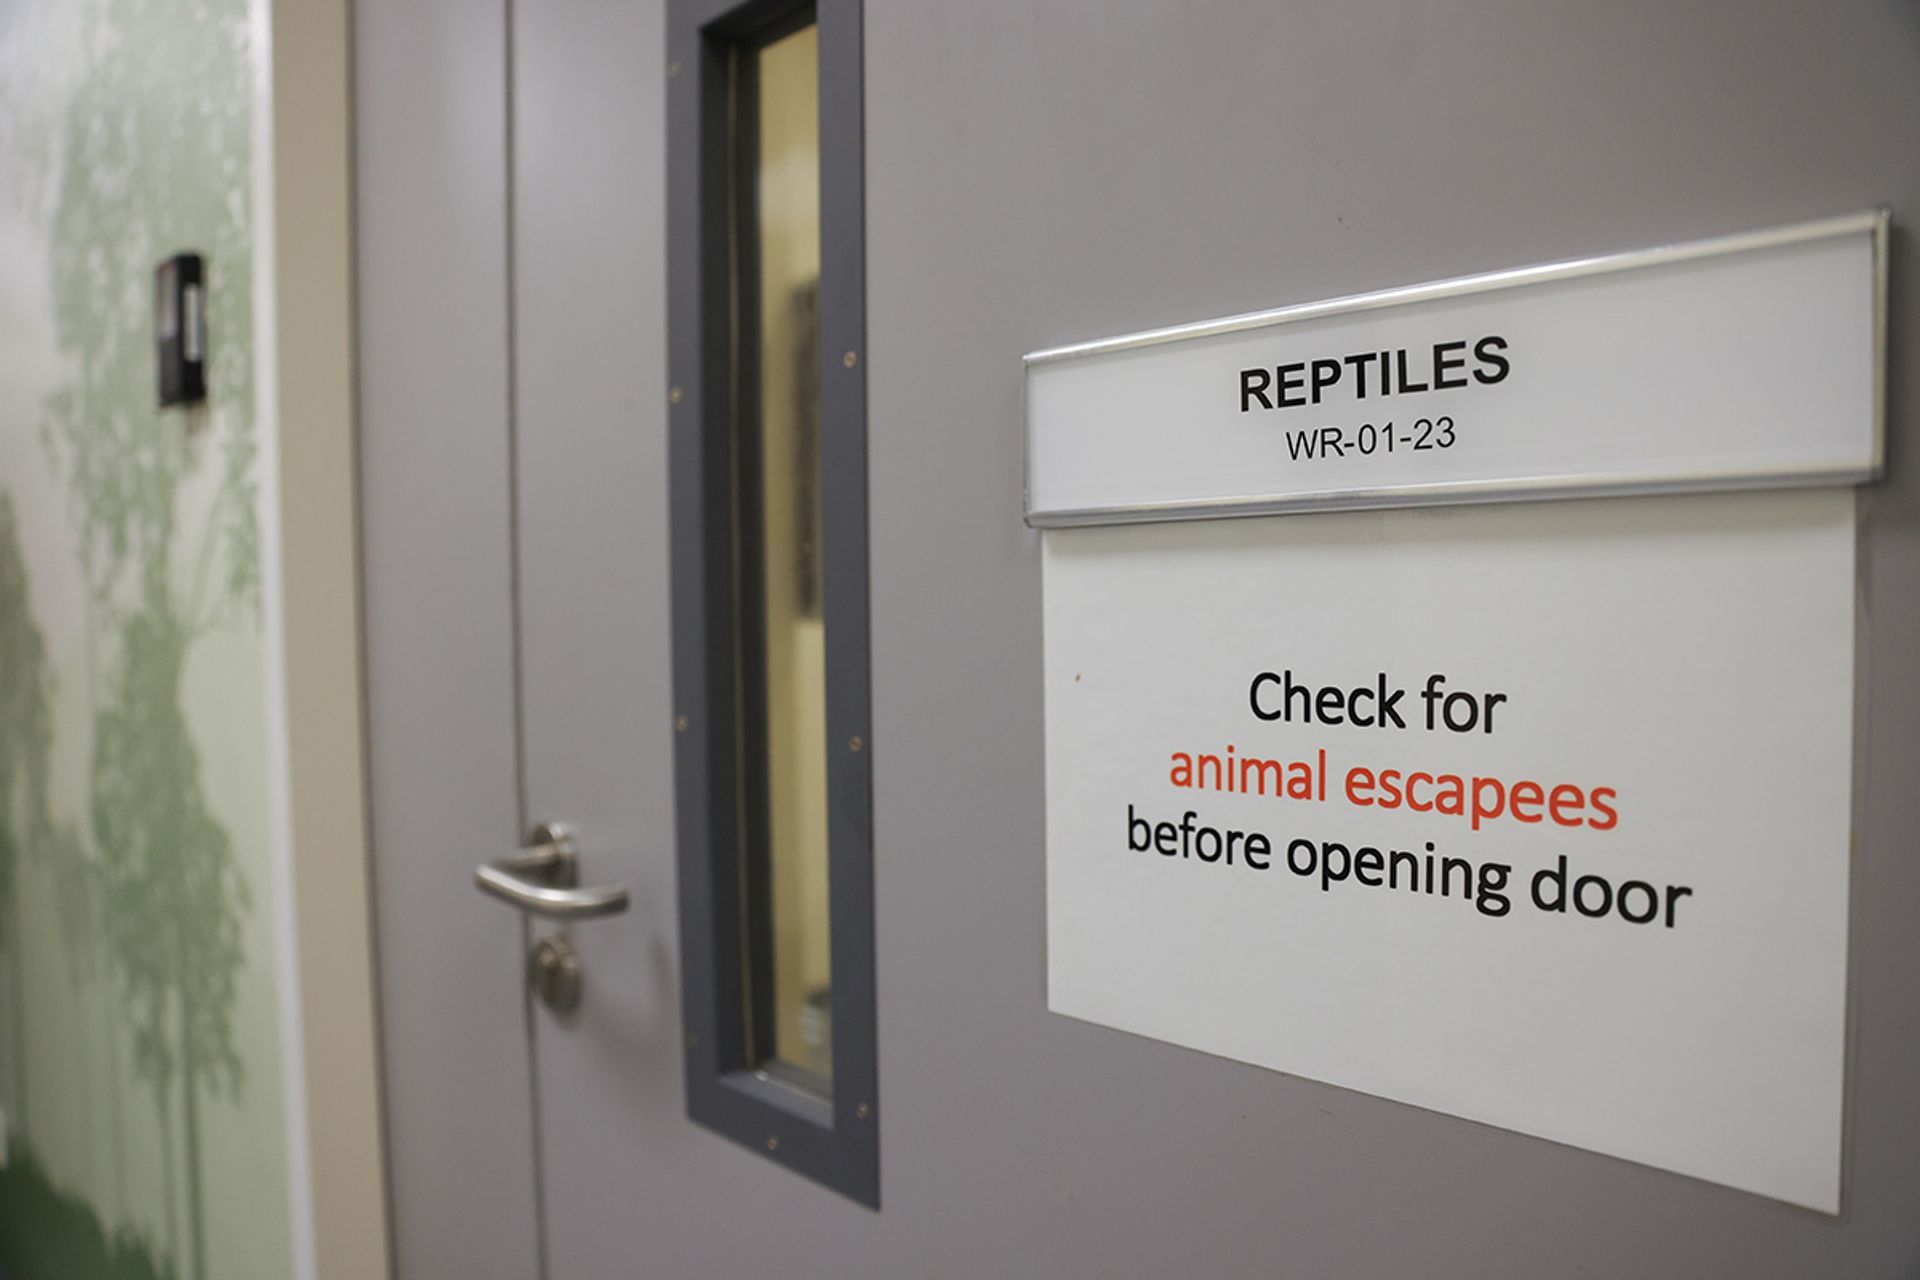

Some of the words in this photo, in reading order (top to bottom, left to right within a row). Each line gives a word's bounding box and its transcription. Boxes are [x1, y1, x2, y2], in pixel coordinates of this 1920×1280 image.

[1239, 335, 1511, 413] REPTILES
[1285, 415, 1456, 461] WR-01-23
[1249, 669, 1407, 730] Check
[1421, 673, 1508, 735] for
[1169, 744, 1327, 802] animal
[1344, 766, 1619, 832] escapees
[1127, 803, 1272, 871] before
[1286, 838, 1513, 918] opening
[1530, 854, 1694, 929] door
